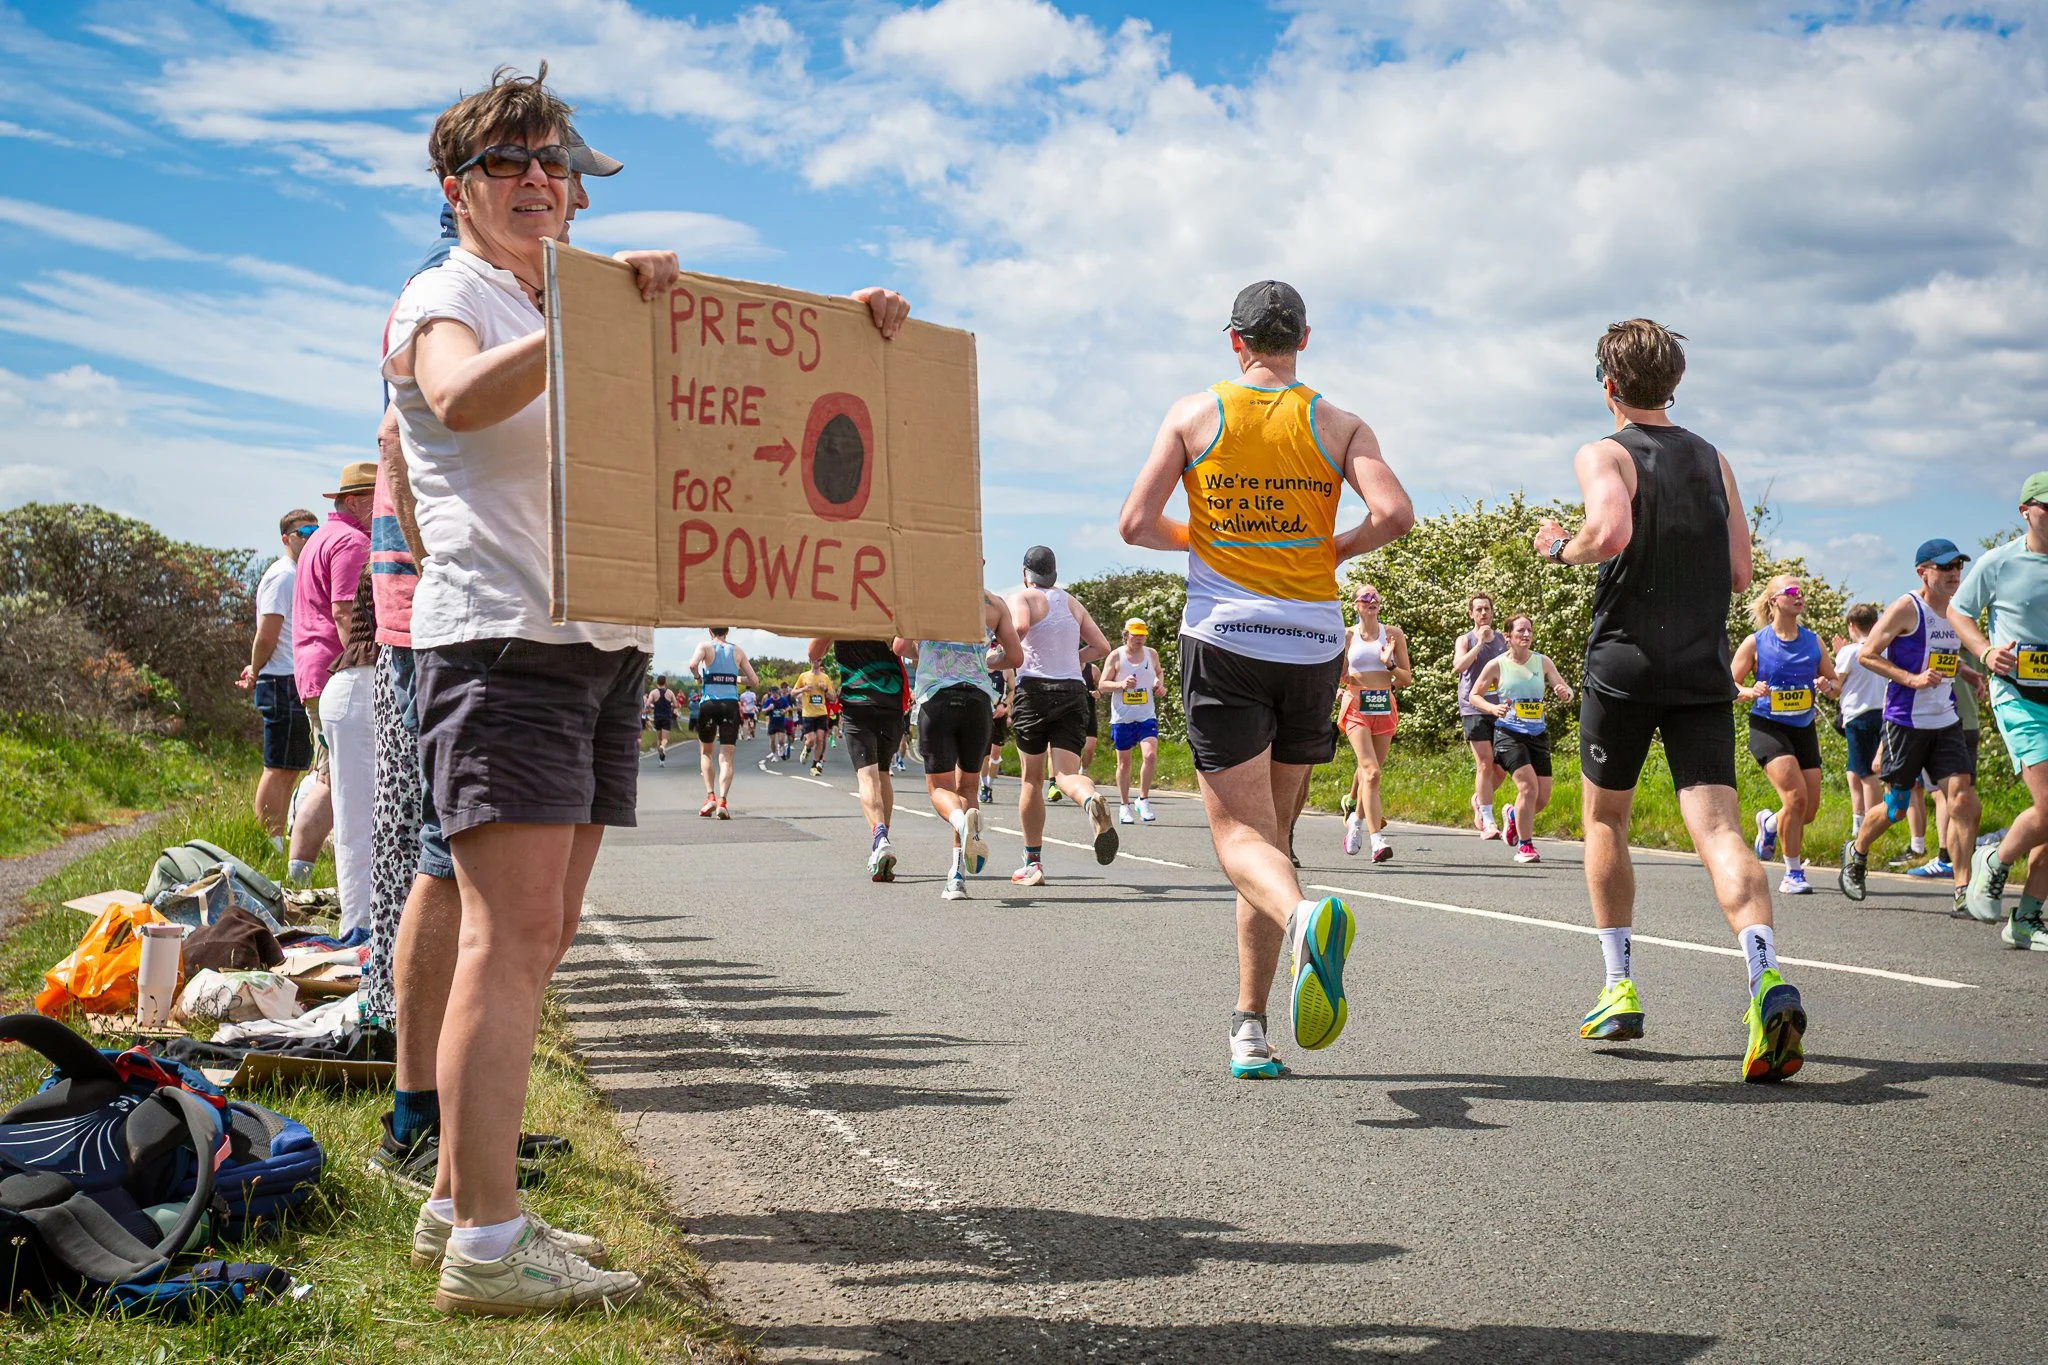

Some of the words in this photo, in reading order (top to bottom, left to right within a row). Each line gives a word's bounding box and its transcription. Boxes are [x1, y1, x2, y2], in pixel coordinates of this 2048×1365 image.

[669, 286, 821, 373] PRESS
[667, 374, 766, 427] HERE
[671, 468, 734, 514] FOR
[1205, 473, 1259, 489] We're
[1265, 476, 1333, 498] running
[1206, 495, 1233, 510] for
[1239, 498, 1249, 509] a
[1255, 495, 1284, 511] life
[1209, 513, 1308, 533] unlimited
[677, 518, 894, 621] POWER
[1214, 622, 1338, 644] cysticfibrosis.org.uk
[1365, 694, 1387, 703] 5286
[1777, 691, 1804, 701] 3007
